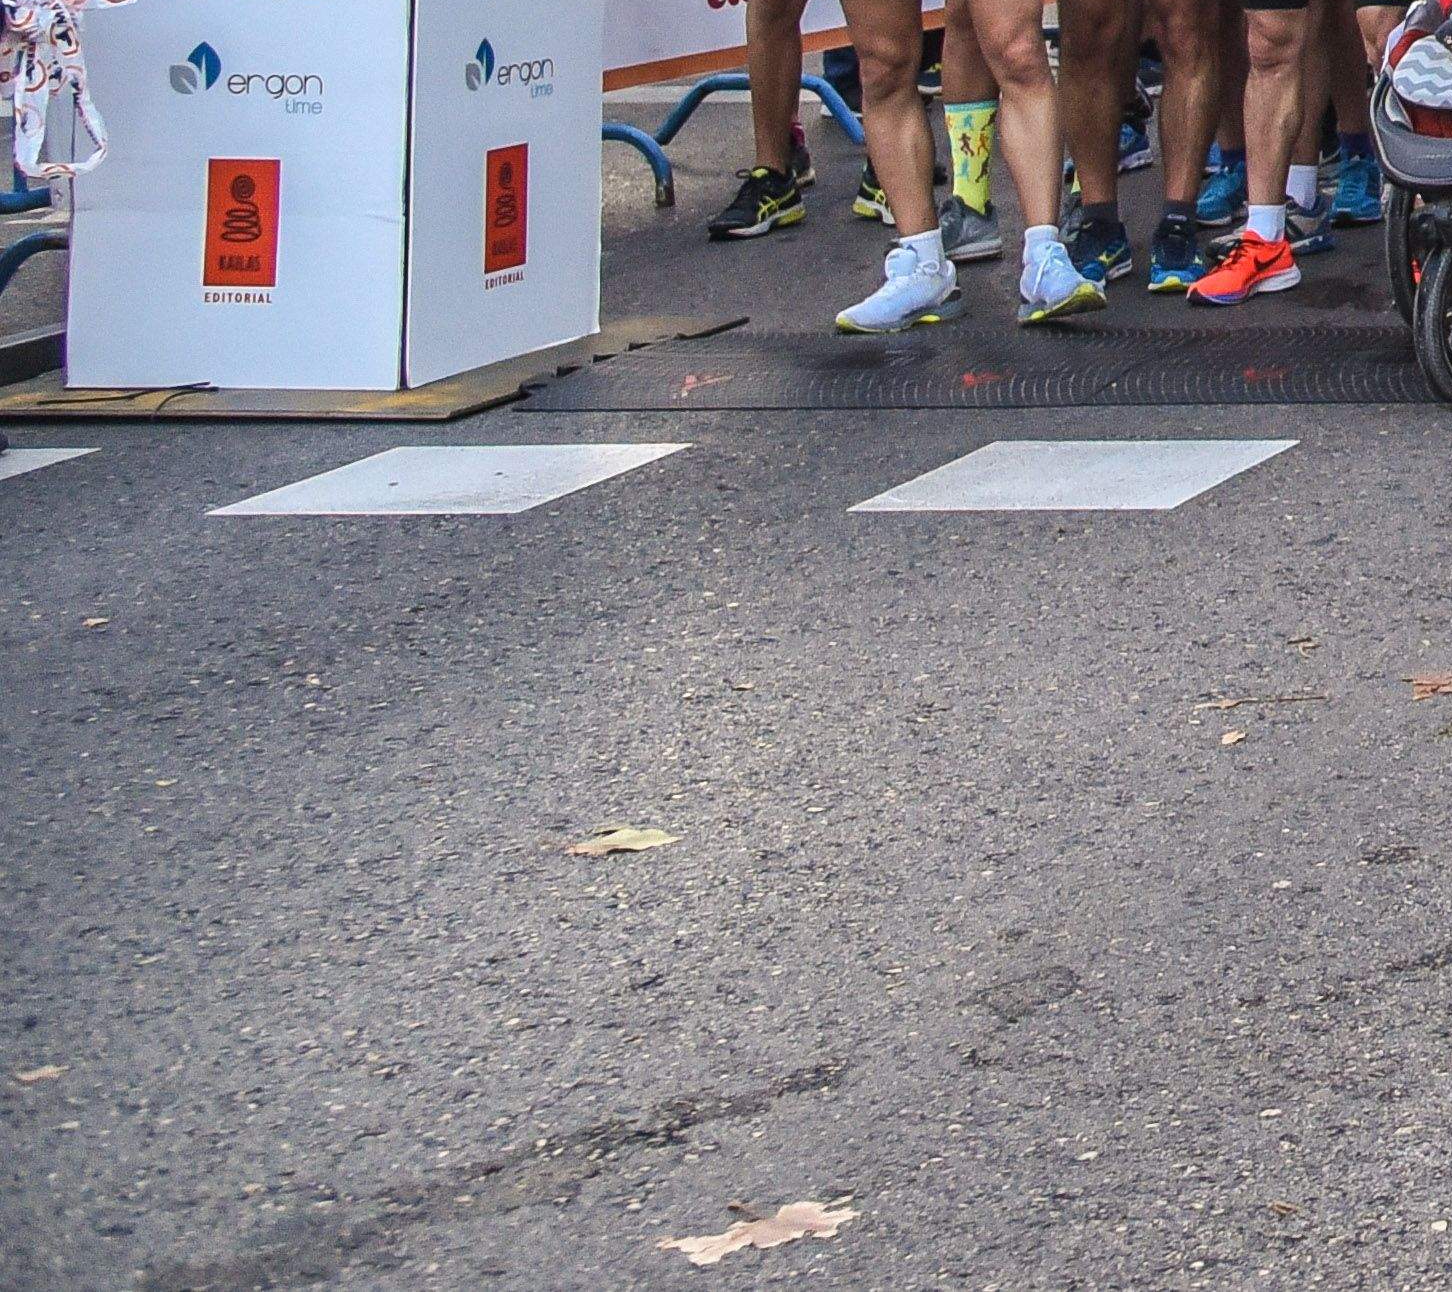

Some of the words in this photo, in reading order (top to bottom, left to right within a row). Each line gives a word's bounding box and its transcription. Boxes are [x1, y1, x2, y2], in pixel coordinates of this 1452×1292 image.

[226, 70, 325, 99] ergon
[284, 97, 323, 115] time
[204, 291, 273, 305] EDITORIAL
